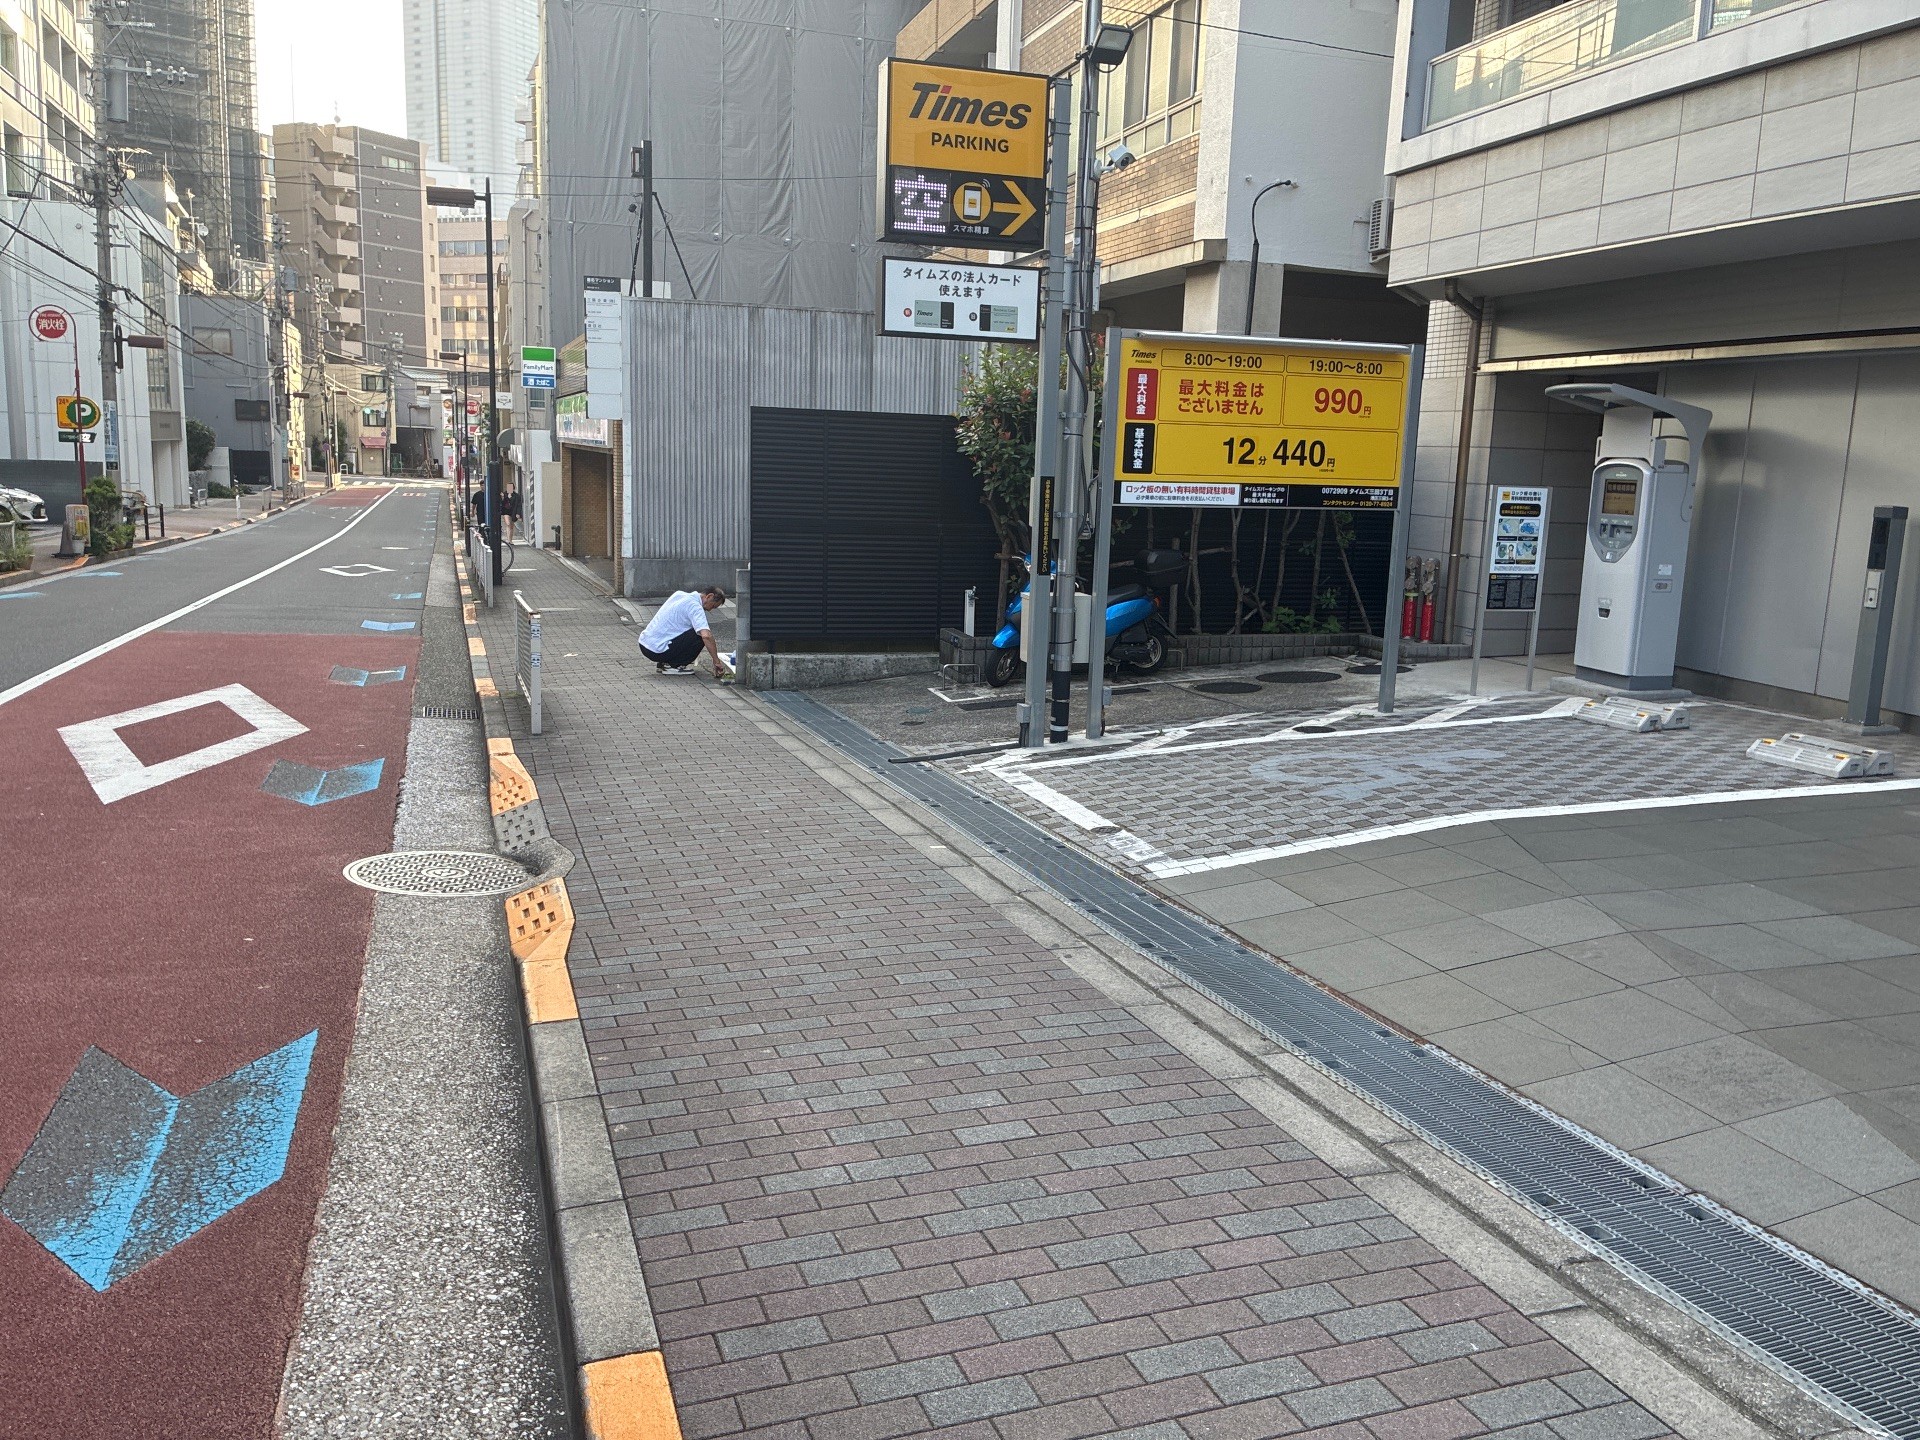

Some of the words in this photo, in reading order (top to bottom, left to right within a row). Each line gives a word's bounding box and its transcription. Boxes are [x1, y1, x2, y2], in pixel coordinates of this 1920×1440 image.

[909, 82, 1032, 130] Times
[932, 132, 1010, 154] PARKING
[894, 174, 947, 233] 空
[953, 224, 990, 235] スマホ精算
[902, 267, 1022, 286] タイムズの法人カード
[939, 286, 985, 298] 使えます
[38, 318, 66, 330] 消火栓
[1130, 349, 1157, 359] Times
[1184, 354, 1262, 368] 8:00〜19:00
[1310, 360, 1382, 374] 19:00〜8:00
[1136, 374, 1148, 414] 最大料金
[1178, 379, 1264, 397] 最大料金は
[1178, 397, 1264, 415] ございません
[1314, 387, 1371, 415] 990円
[75, 404, 92, 422] P
[1133, 428, 1144, 468] 基本料金
[1222, 437, 1267, 465] 12分
[1273, 439, 1335, 467] 440円
[1126, 486, 1235, 495] ロック板の無い有料時間貸駐車場
